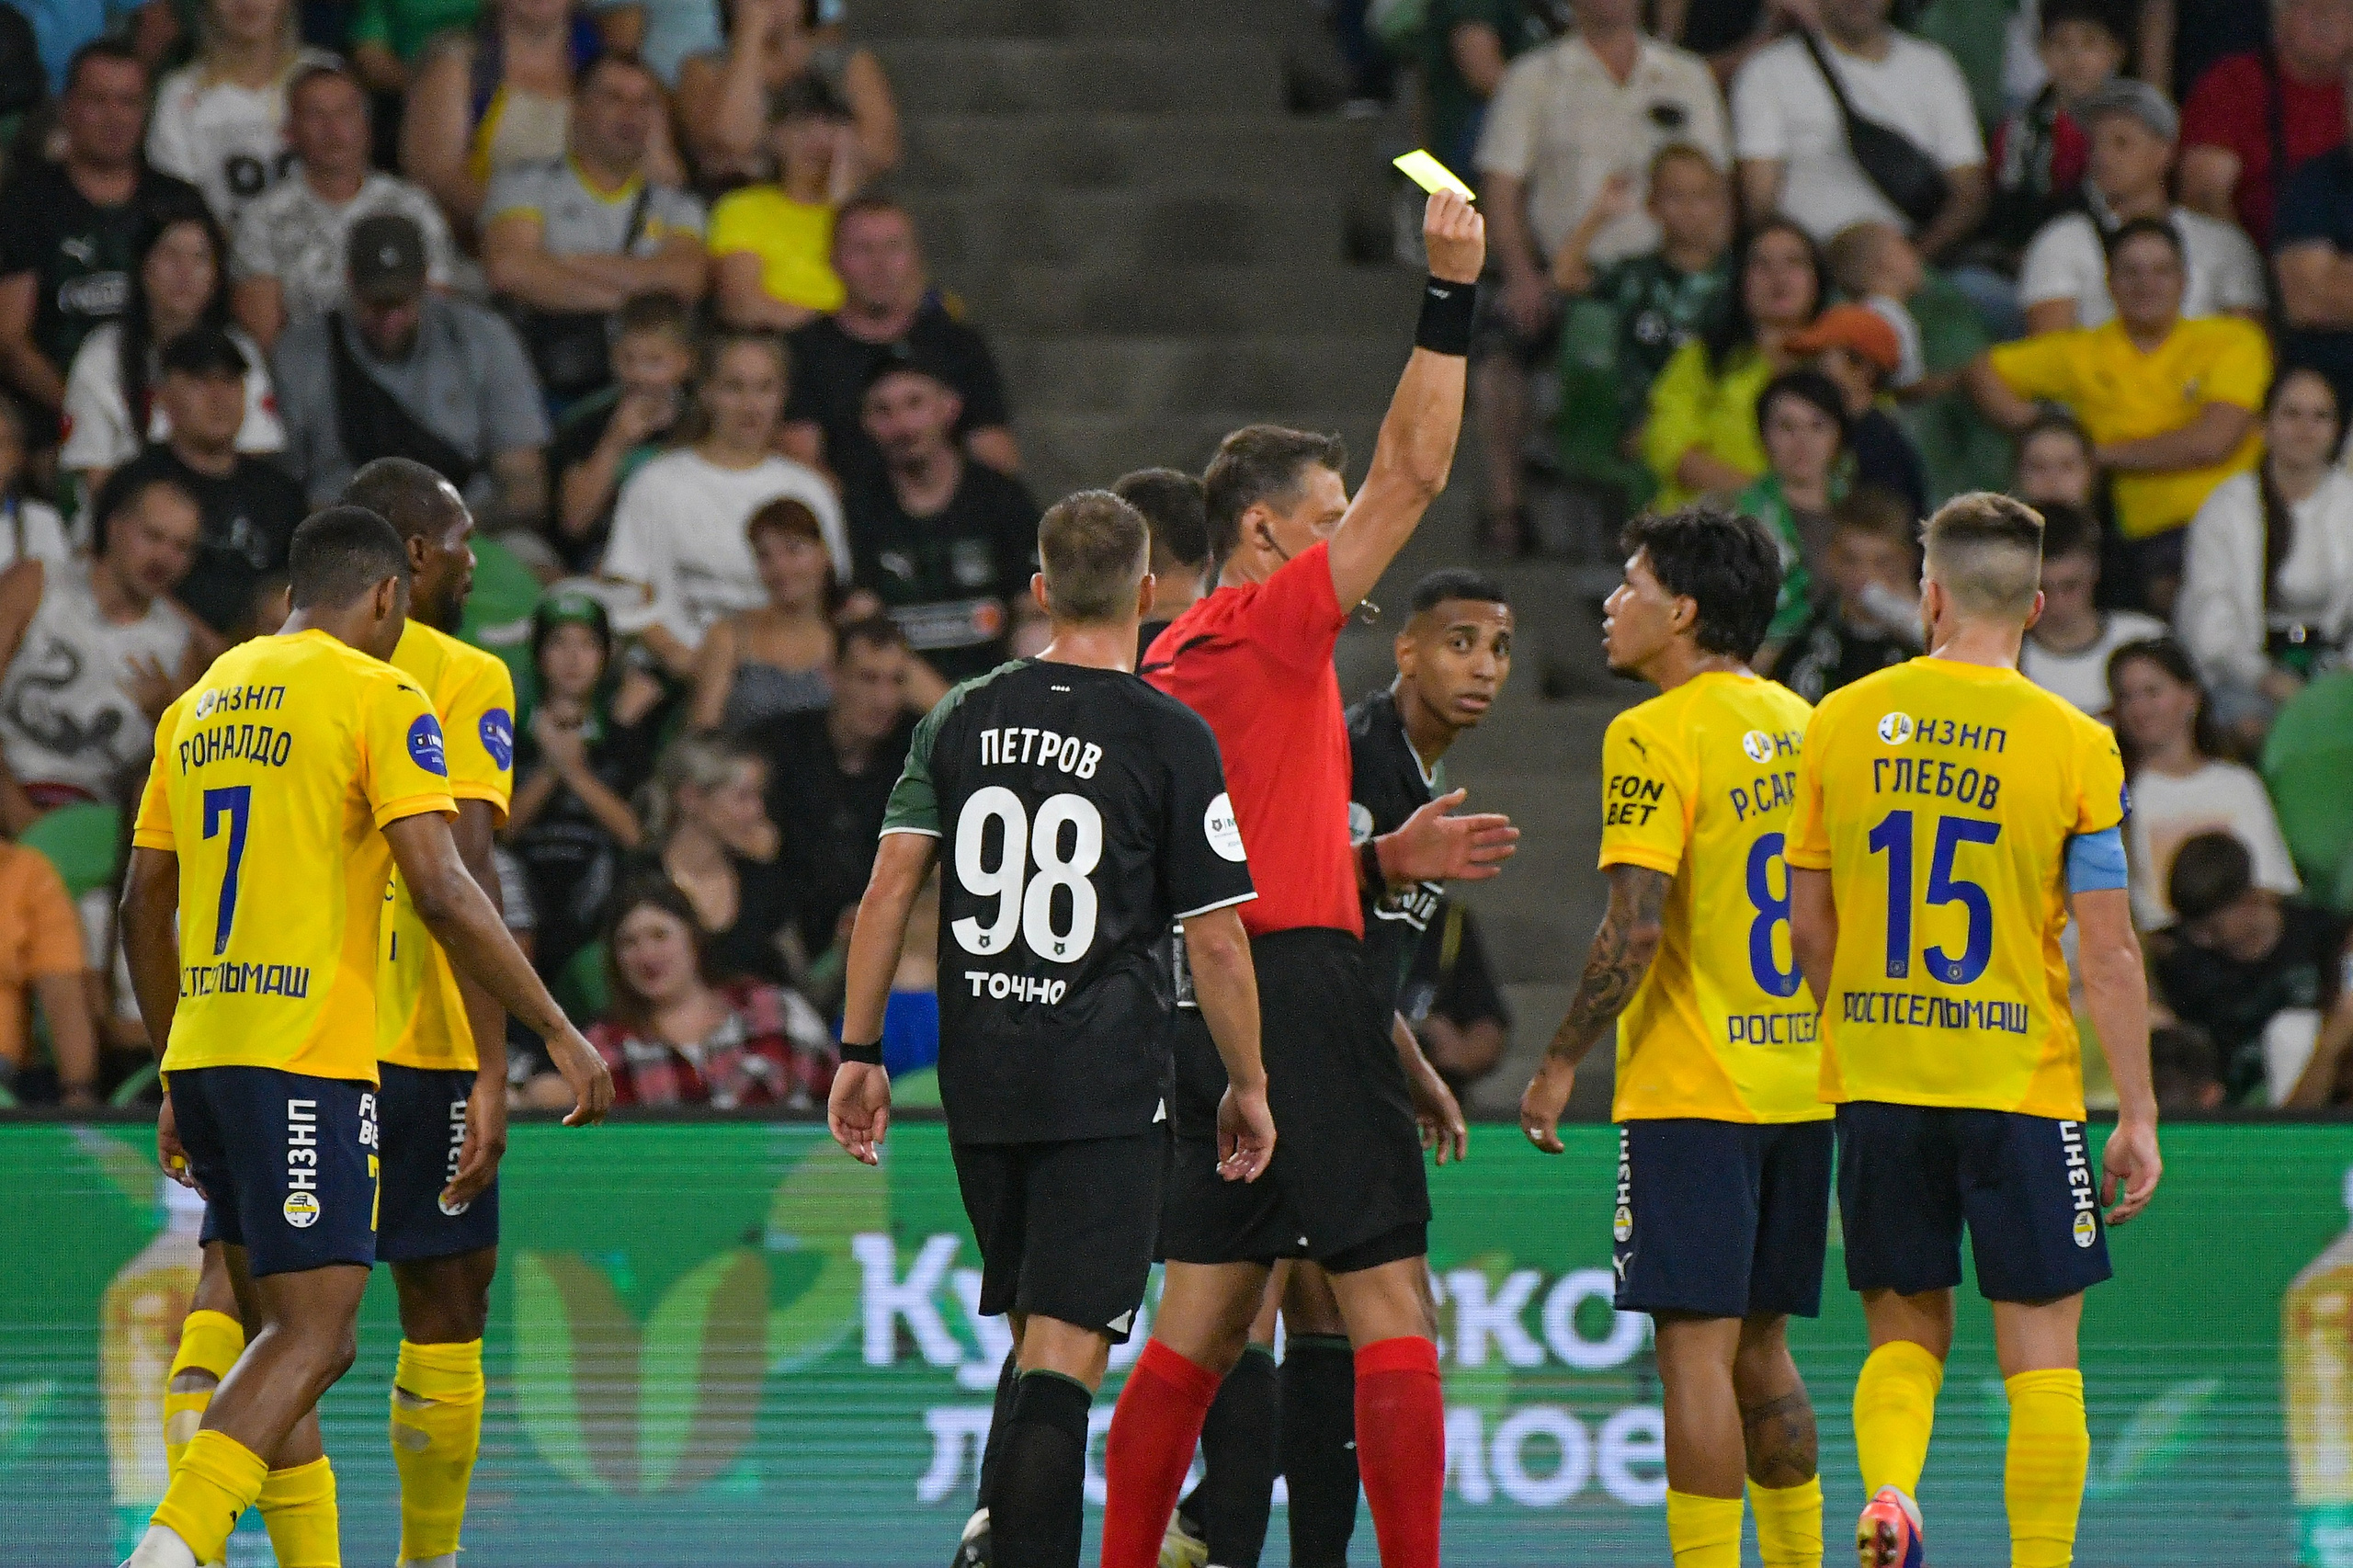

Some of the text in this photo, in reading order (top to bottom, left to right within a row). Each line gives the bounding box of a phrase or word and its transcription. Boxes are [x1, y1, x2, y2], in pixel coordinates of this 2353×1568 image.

[216, 685, 286, 713] НЗНП
[179, 724, 292, 777] РОНАЛДО
[980, 727, 1103, 780] ПЕТРОВ
[1915, 720, 2006, 754] НЗНП
[1608, 776, 1665, 801] FON
[1873, 758, 2001, 811] ГЛЕБОВ
[1607, 802, 1657, 826] BET
[202, 785, 252, 956] 7
[951, 786, 1102, 963] 98
[1746, 832, 1802, 998] 8
[1869, 810, 2001, 985] 15
[964, 971, 1067, 1006] ТОЧНО
[1843, 992, 2029, 1035] РОСТСЕЛЬМАШ
[288, 1099, 317, 1190] НЗНП
[2062, 1122, 2095, 1210] НЗНП
